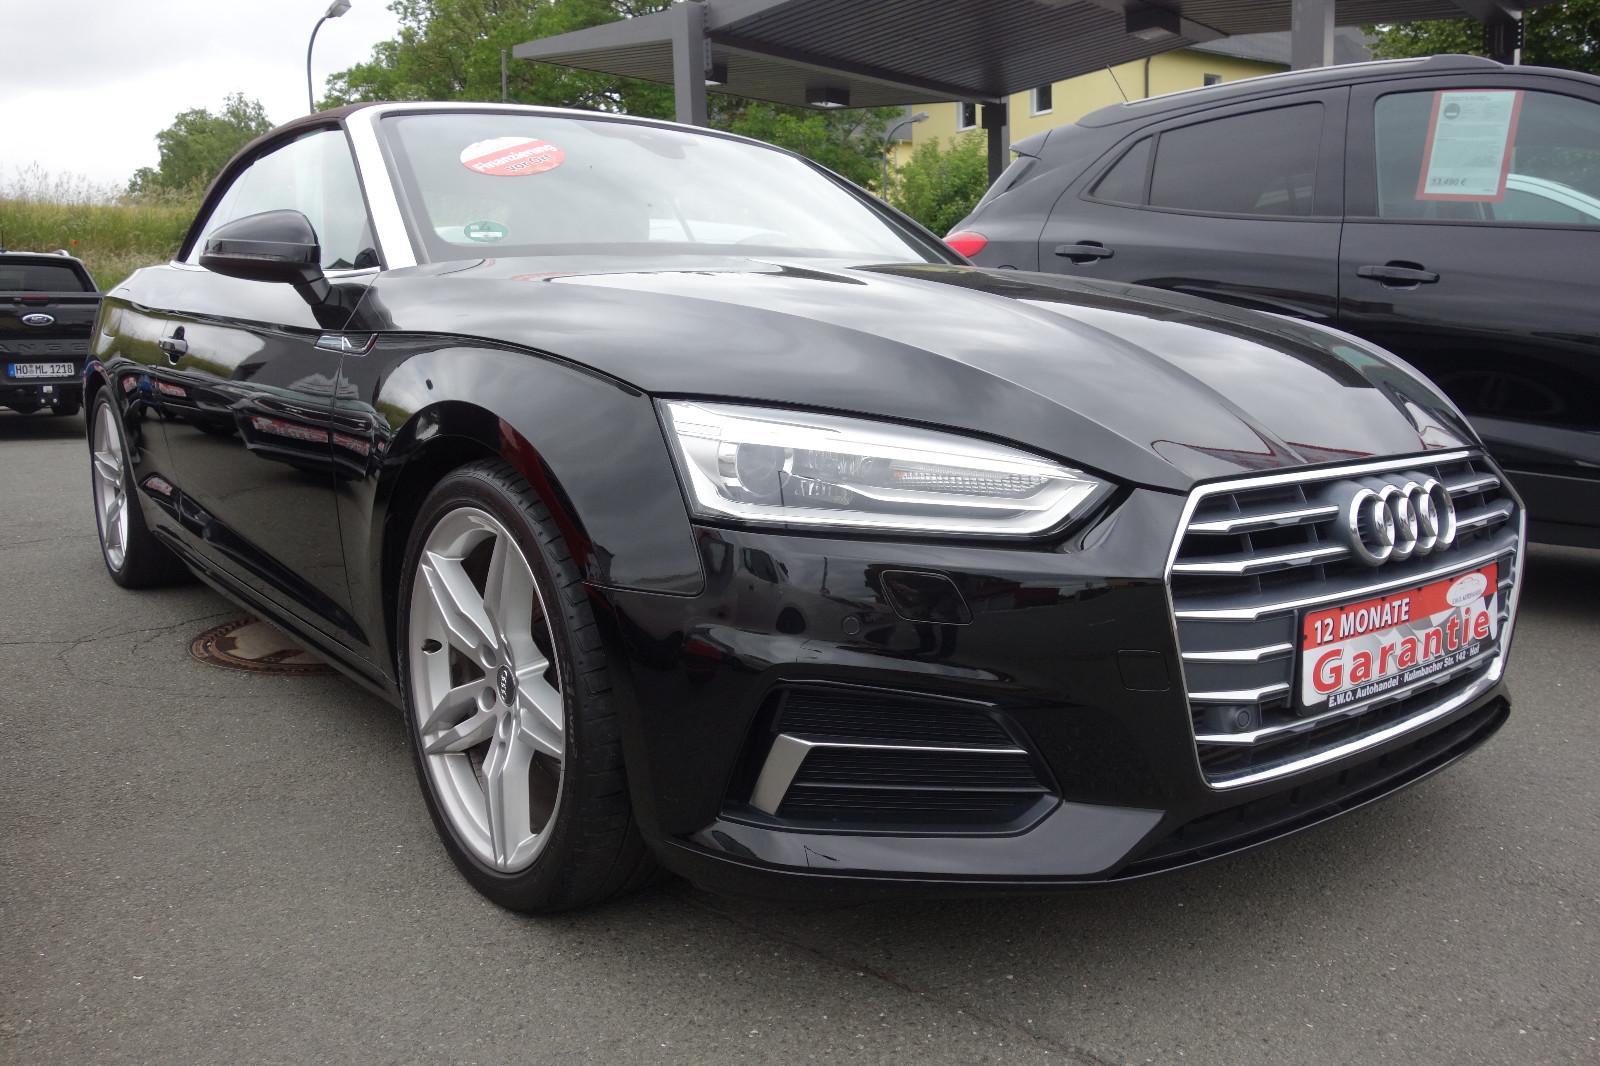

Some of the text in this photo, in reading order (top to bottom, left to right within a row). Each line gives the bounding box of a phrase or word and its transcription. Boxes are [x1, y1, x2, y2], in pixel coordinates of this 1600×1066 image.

[15, 363, 73, 375] HO ML 1218
[1314, 597, 1410, 644] 12 MONATE
[1312, 607, 1490, 694] Garantie
[1328, 693, 1355, 708] E.W.O.
[1356, 677, 1399, 699] Autohandel
[1404, 662, 1443, 683] Kulmbacher
[1469, 643, 1480, 657] Hof
